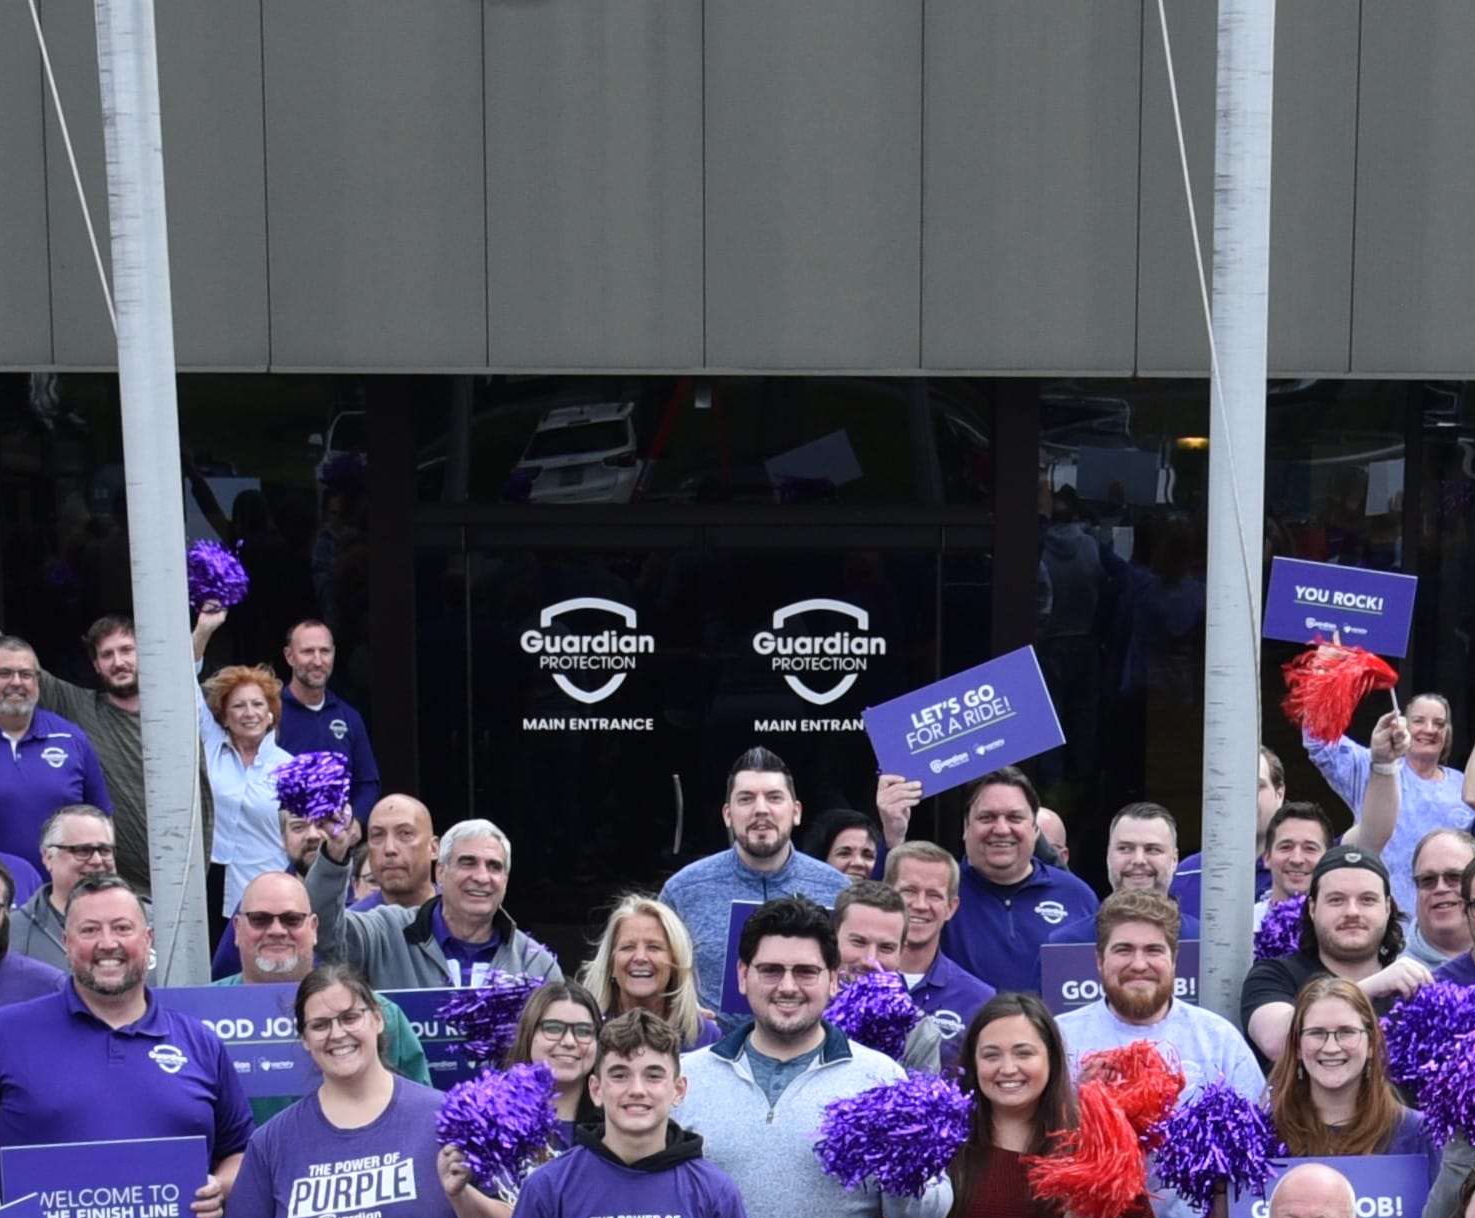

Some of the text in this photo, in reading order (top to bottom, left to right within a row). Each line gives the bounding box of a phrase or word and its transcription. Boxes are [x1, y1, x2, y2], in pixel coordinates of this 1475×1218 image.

[1294, 585, 1384, 612] YOU ROCK!
[520, 629, 655, 653] Guardian
[752, 631, 886, 655] Guardian
[539, 655, 636, 670] PROTECTION
[771, 656, 866, 671] PROTECTION
[910, 684, 995, 729] LET'S GO
[522, 718, 654, 731] MAIN ENTRANCE
[753, 719, 866, 732] MAIN ENTRAN
[906, 696, 1013, 750] FOR A RIDE!
[261, 1017, 299, 1039] JO
[309, 1152, 400, 1178] THE POWER OF
[40, 1183, 180, 1209] WELCOME TO
[291, 1163, 413, 1217] PURPLE
[140, 1203, 180, 1218] LINE
